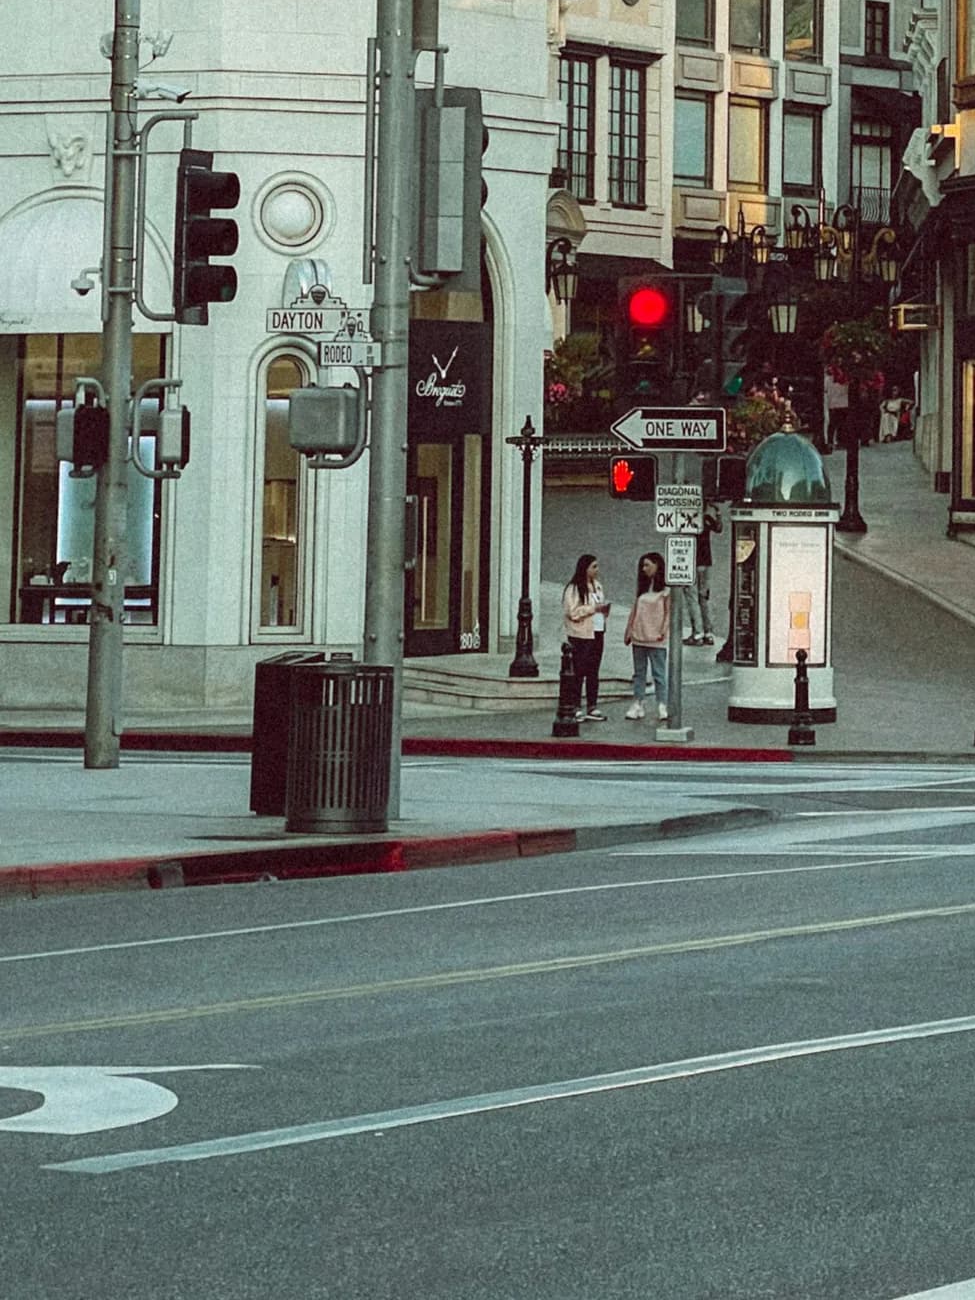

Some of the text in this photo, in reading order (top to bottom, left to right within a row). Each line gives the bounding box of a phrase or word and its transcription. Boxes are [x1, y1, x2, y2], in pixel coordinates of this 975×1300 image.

[272, 311, 323, 330] DAYTON
[324, 345, 352, 363] RODEO
[645, 421, 710, 437] ONE WAY
[658, 486, 700, 497] DIAGONAL
[657, 498, 702, 508] CROSSING
[657, 512, 674, 528] OK
[772, 510, 787, 518] TWO
[789, 510, 812, 518] RODEO
[670, 540, 692, 548] CROSS
